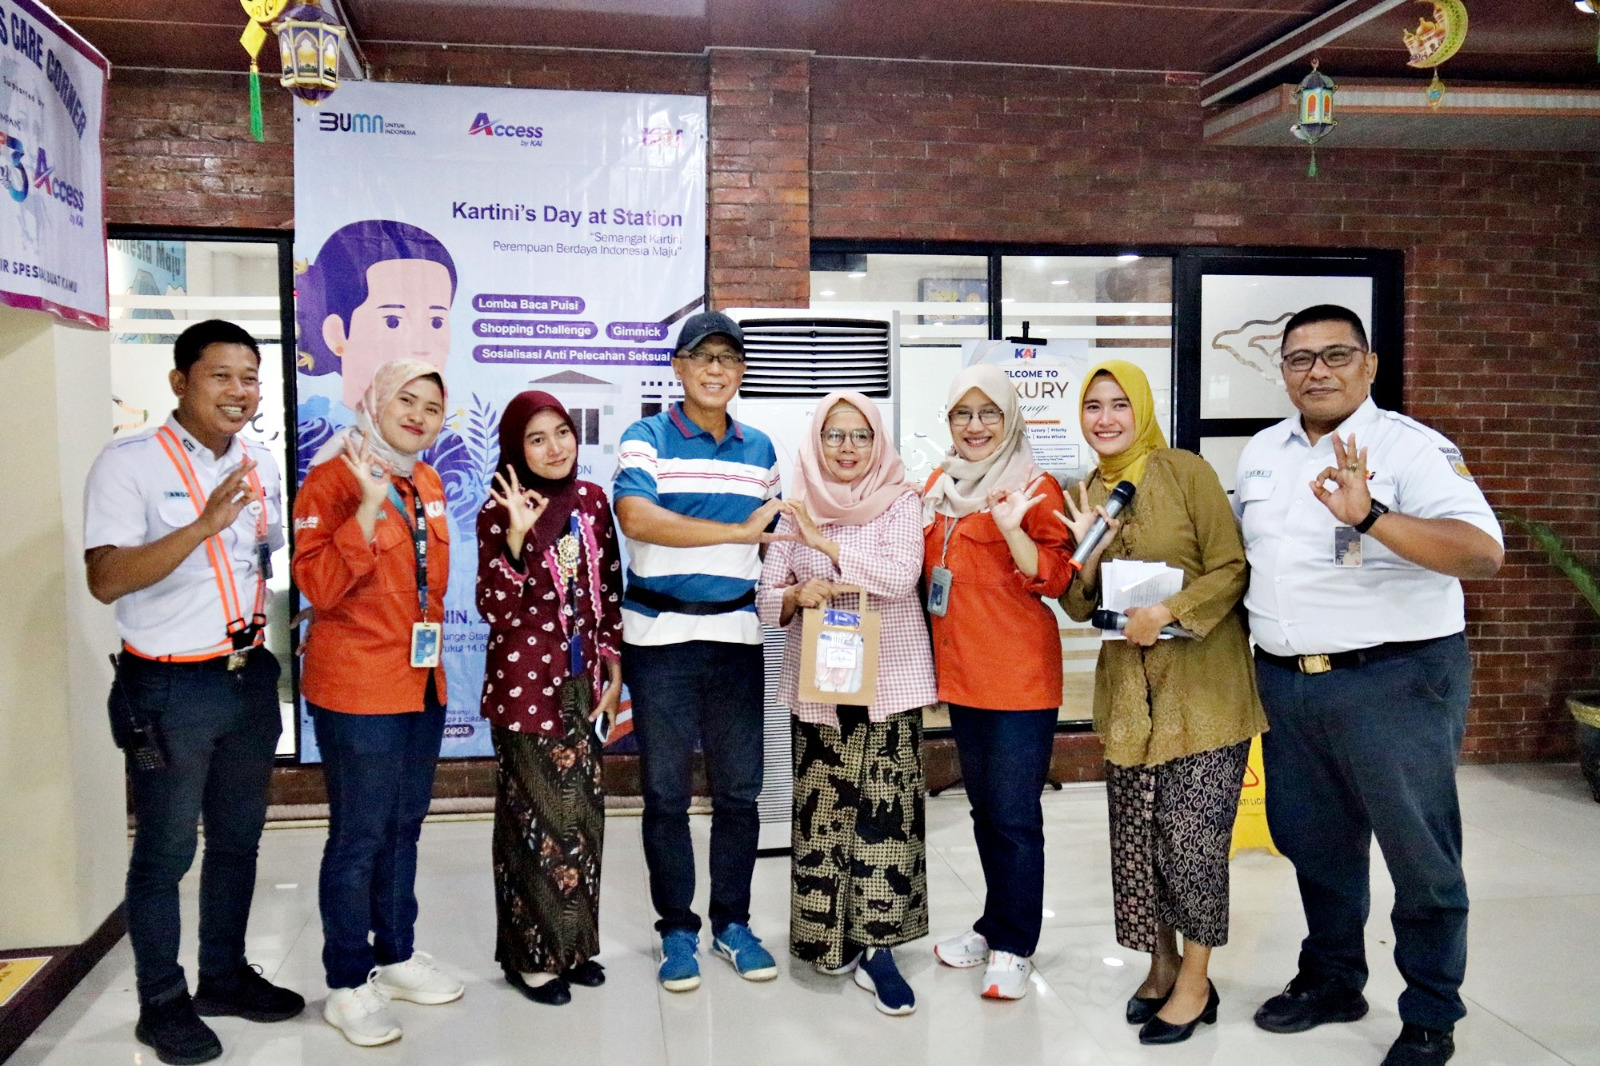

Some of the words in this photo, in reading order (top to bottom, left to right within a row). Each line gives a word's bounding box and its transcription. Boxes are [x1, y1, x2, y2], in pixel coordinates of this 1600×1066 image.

[11, 12, 43, 71] CARE
[47, 49, 87, 140] CORNER
[468, 112, 544, 139] Access
[34, 147, 84, 212] Access
[543, 205, 583, 228] Day
[588, 208, 607, 225] at
[612, 208, 683, 227] Station
[649, 234, 683, 245] Kartini
[493, 240, 554, 254] Perempuan
[556, 243, 598, 256] Berdaya
[600, 245, 650, 257] Indonesia
[478, 298, 518, 309] Lomba
[520, 299, 548, 310] Baca
[550, 300, 579, 311] Puisi
[479, 322, 534, 336] Shopping
[536, 324, 592, 337] Challenge
[612, 326, 661, 337] Gimmick
[482, 348, 542, 360] Sosialisasi
[544, 350, 567, 360] Anti
[628, 351, 671, 362] Seksual
[1014, 348, 1037, 359] KAI
[1045, 370, 1059, 378] TO
[443, 644, 464, 653] ukul
